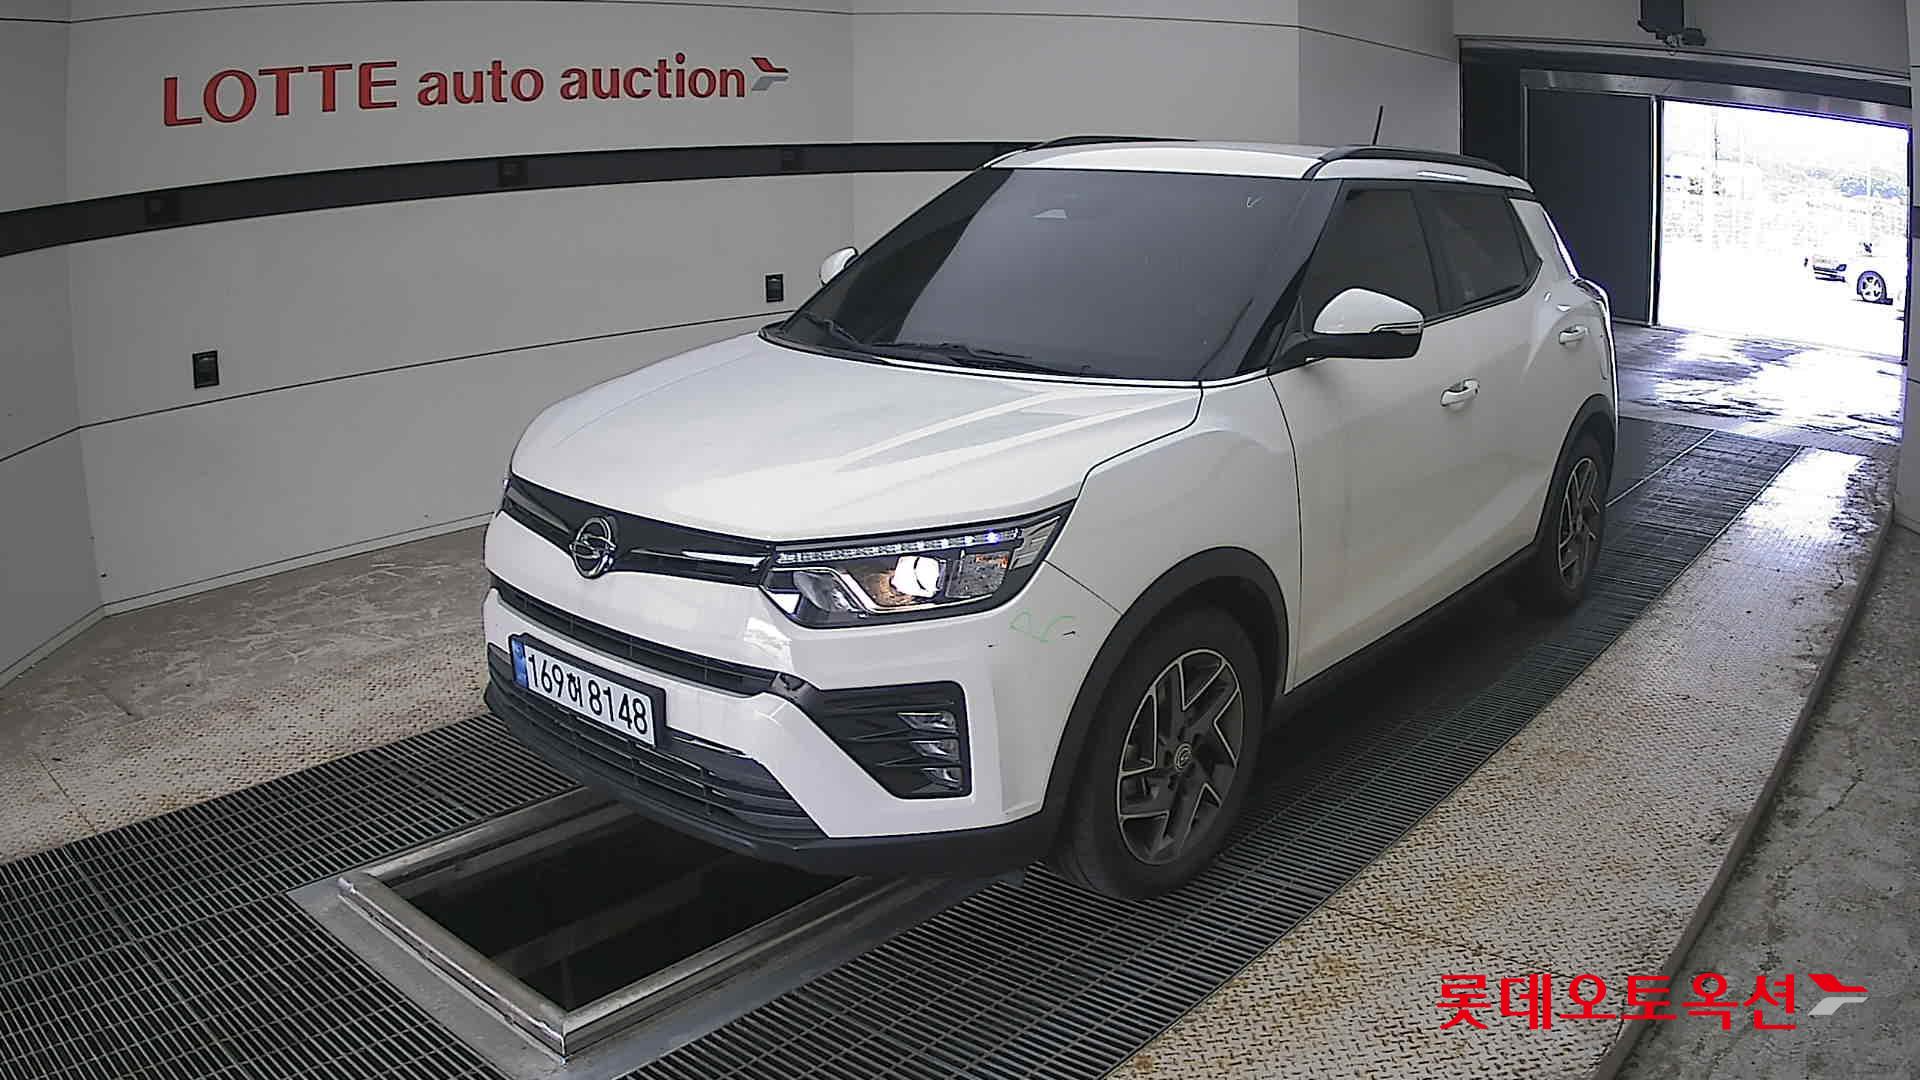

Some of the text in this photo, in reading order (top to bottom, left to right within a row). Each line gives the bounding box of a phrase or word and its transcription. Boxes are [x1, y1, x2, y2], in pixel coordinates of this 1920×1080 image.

[163, 52, 746, 127] LOTTE auto auction
